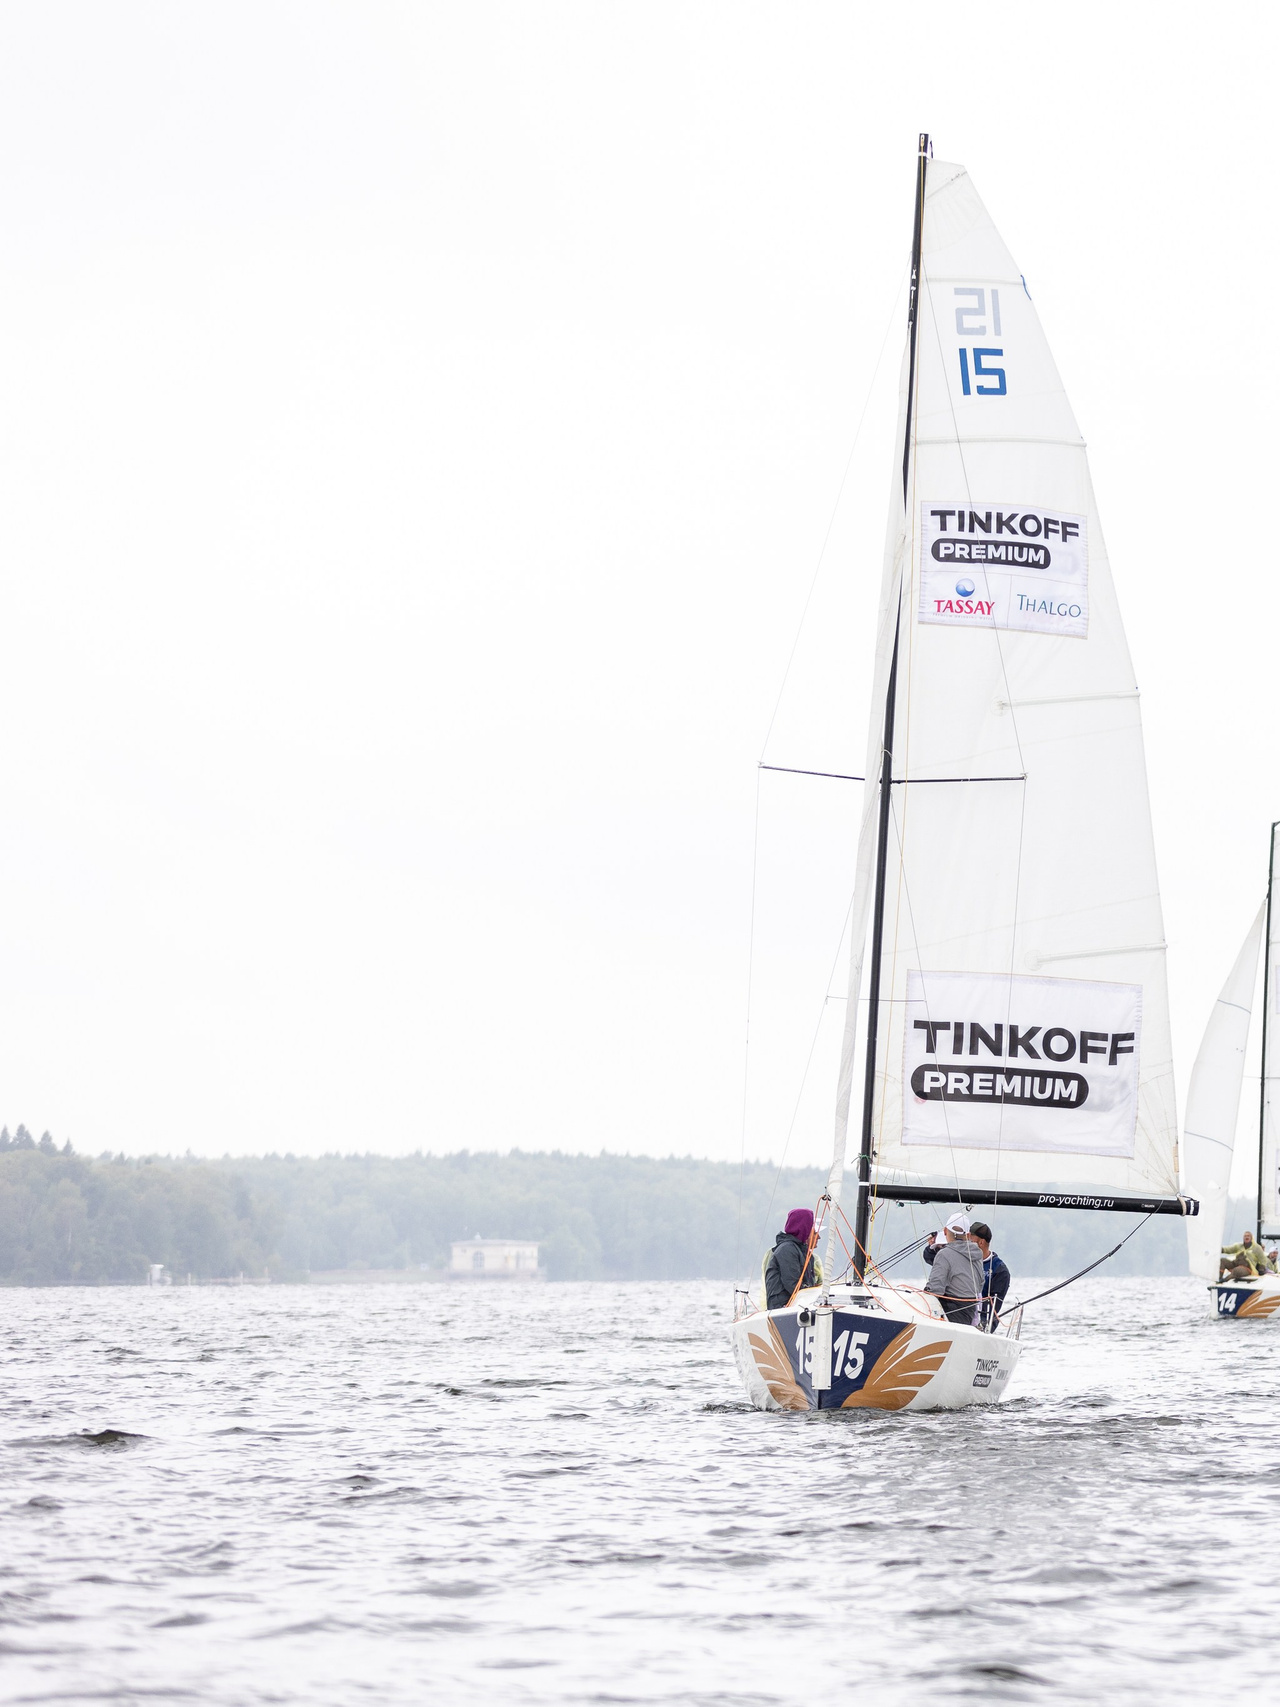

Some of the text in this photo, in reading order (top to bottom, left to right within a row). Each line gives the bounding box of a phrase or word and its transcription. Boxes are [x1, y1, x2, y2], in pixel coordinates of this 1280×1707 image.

[958, 347, 1008, 396] 15
[930, 509, 1080, 543] TINKOFF
[938, 542, 1046, 565] PREMIUM
[933, 599, 996, 616] TASSAY
[913, 1019, 1135, 1066] TINKOFF
[922, 1070, 1079, 1102] PREMIUM
[1037, 1194, 1115, 1209] pro-yachting.ru
[1217, 1292, 1238, 1312] 14
[833, 1329, 870, 1380] 15
